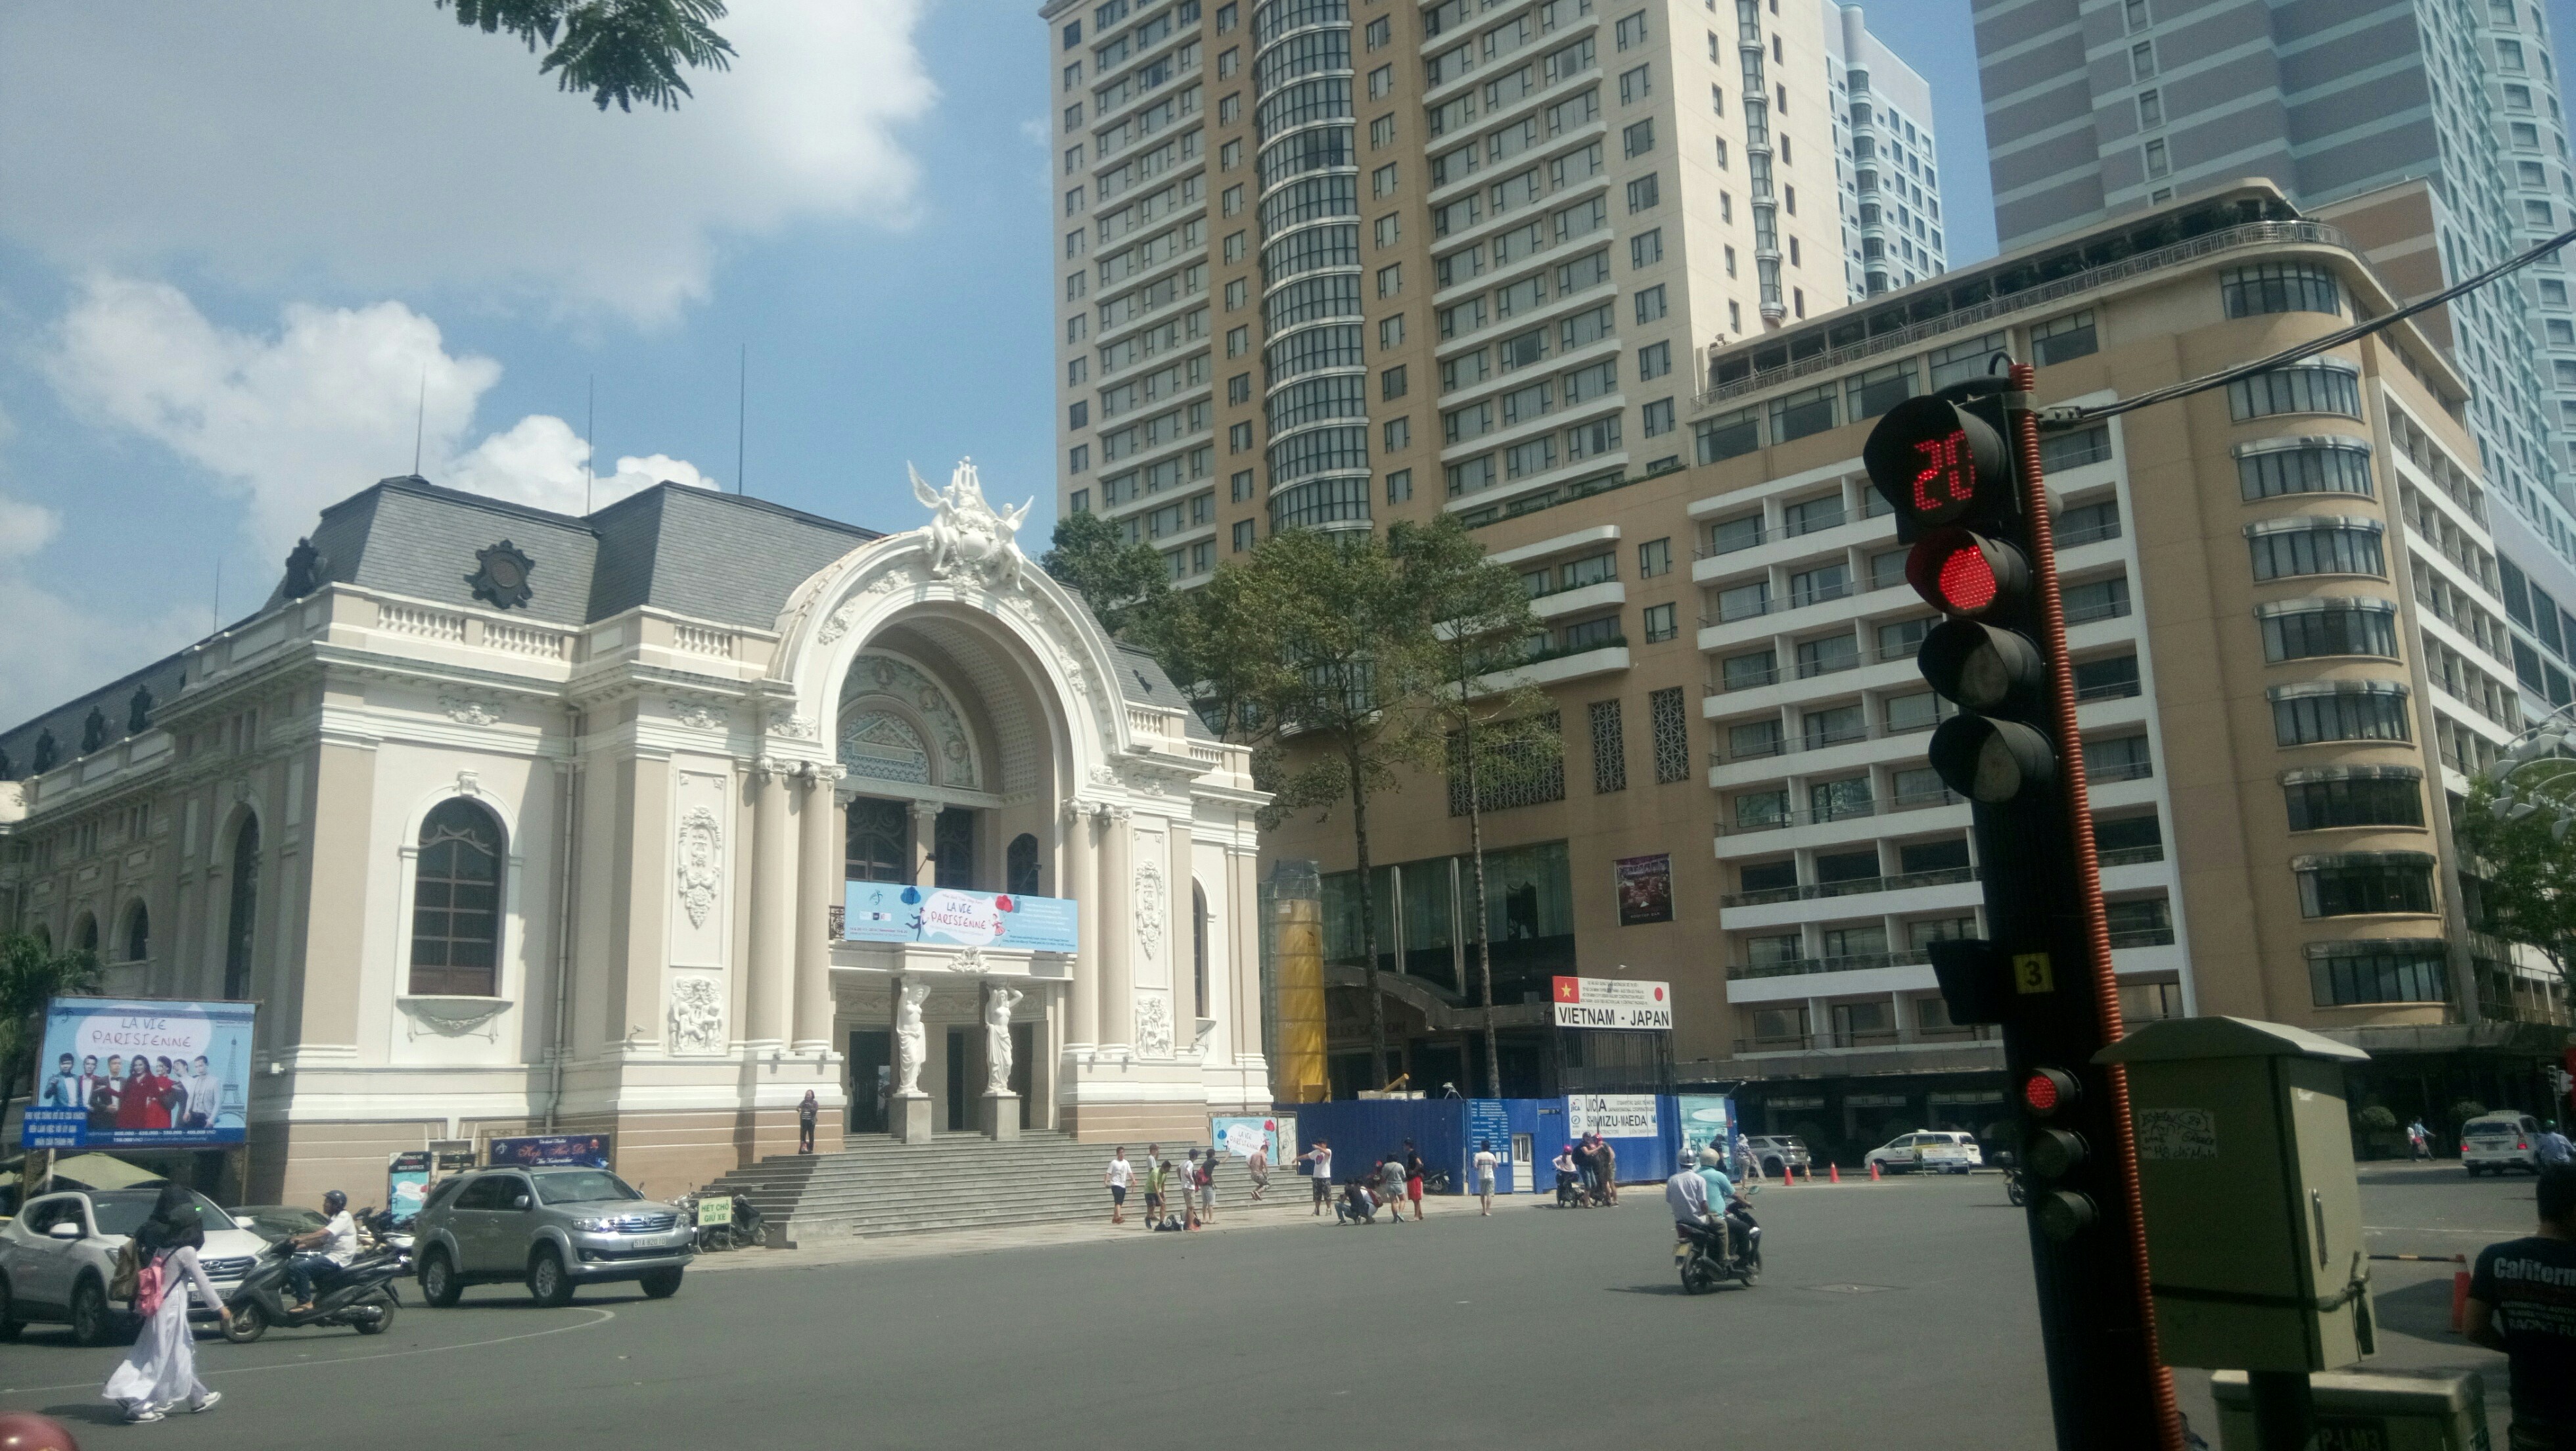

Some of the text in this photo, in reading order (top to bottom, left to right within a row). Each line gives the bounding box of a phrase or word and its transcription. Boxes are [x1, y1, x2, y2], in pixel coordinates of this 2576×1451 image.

[1912, 428, 1976, 511] 20
[946, 902, 972, 914] LA VIE
[931, 911, 986, 929] PARISIENNE
[2024, 960, 2042, 986] 3
[121, 1017, 166, 1030] LA VIE
[1559, 1006, 1615, 1025] VIETNAM
[1630, 1009, 1670, 1026] JAPAN
[92, 1030, 191, 1048] PARISIENNE
